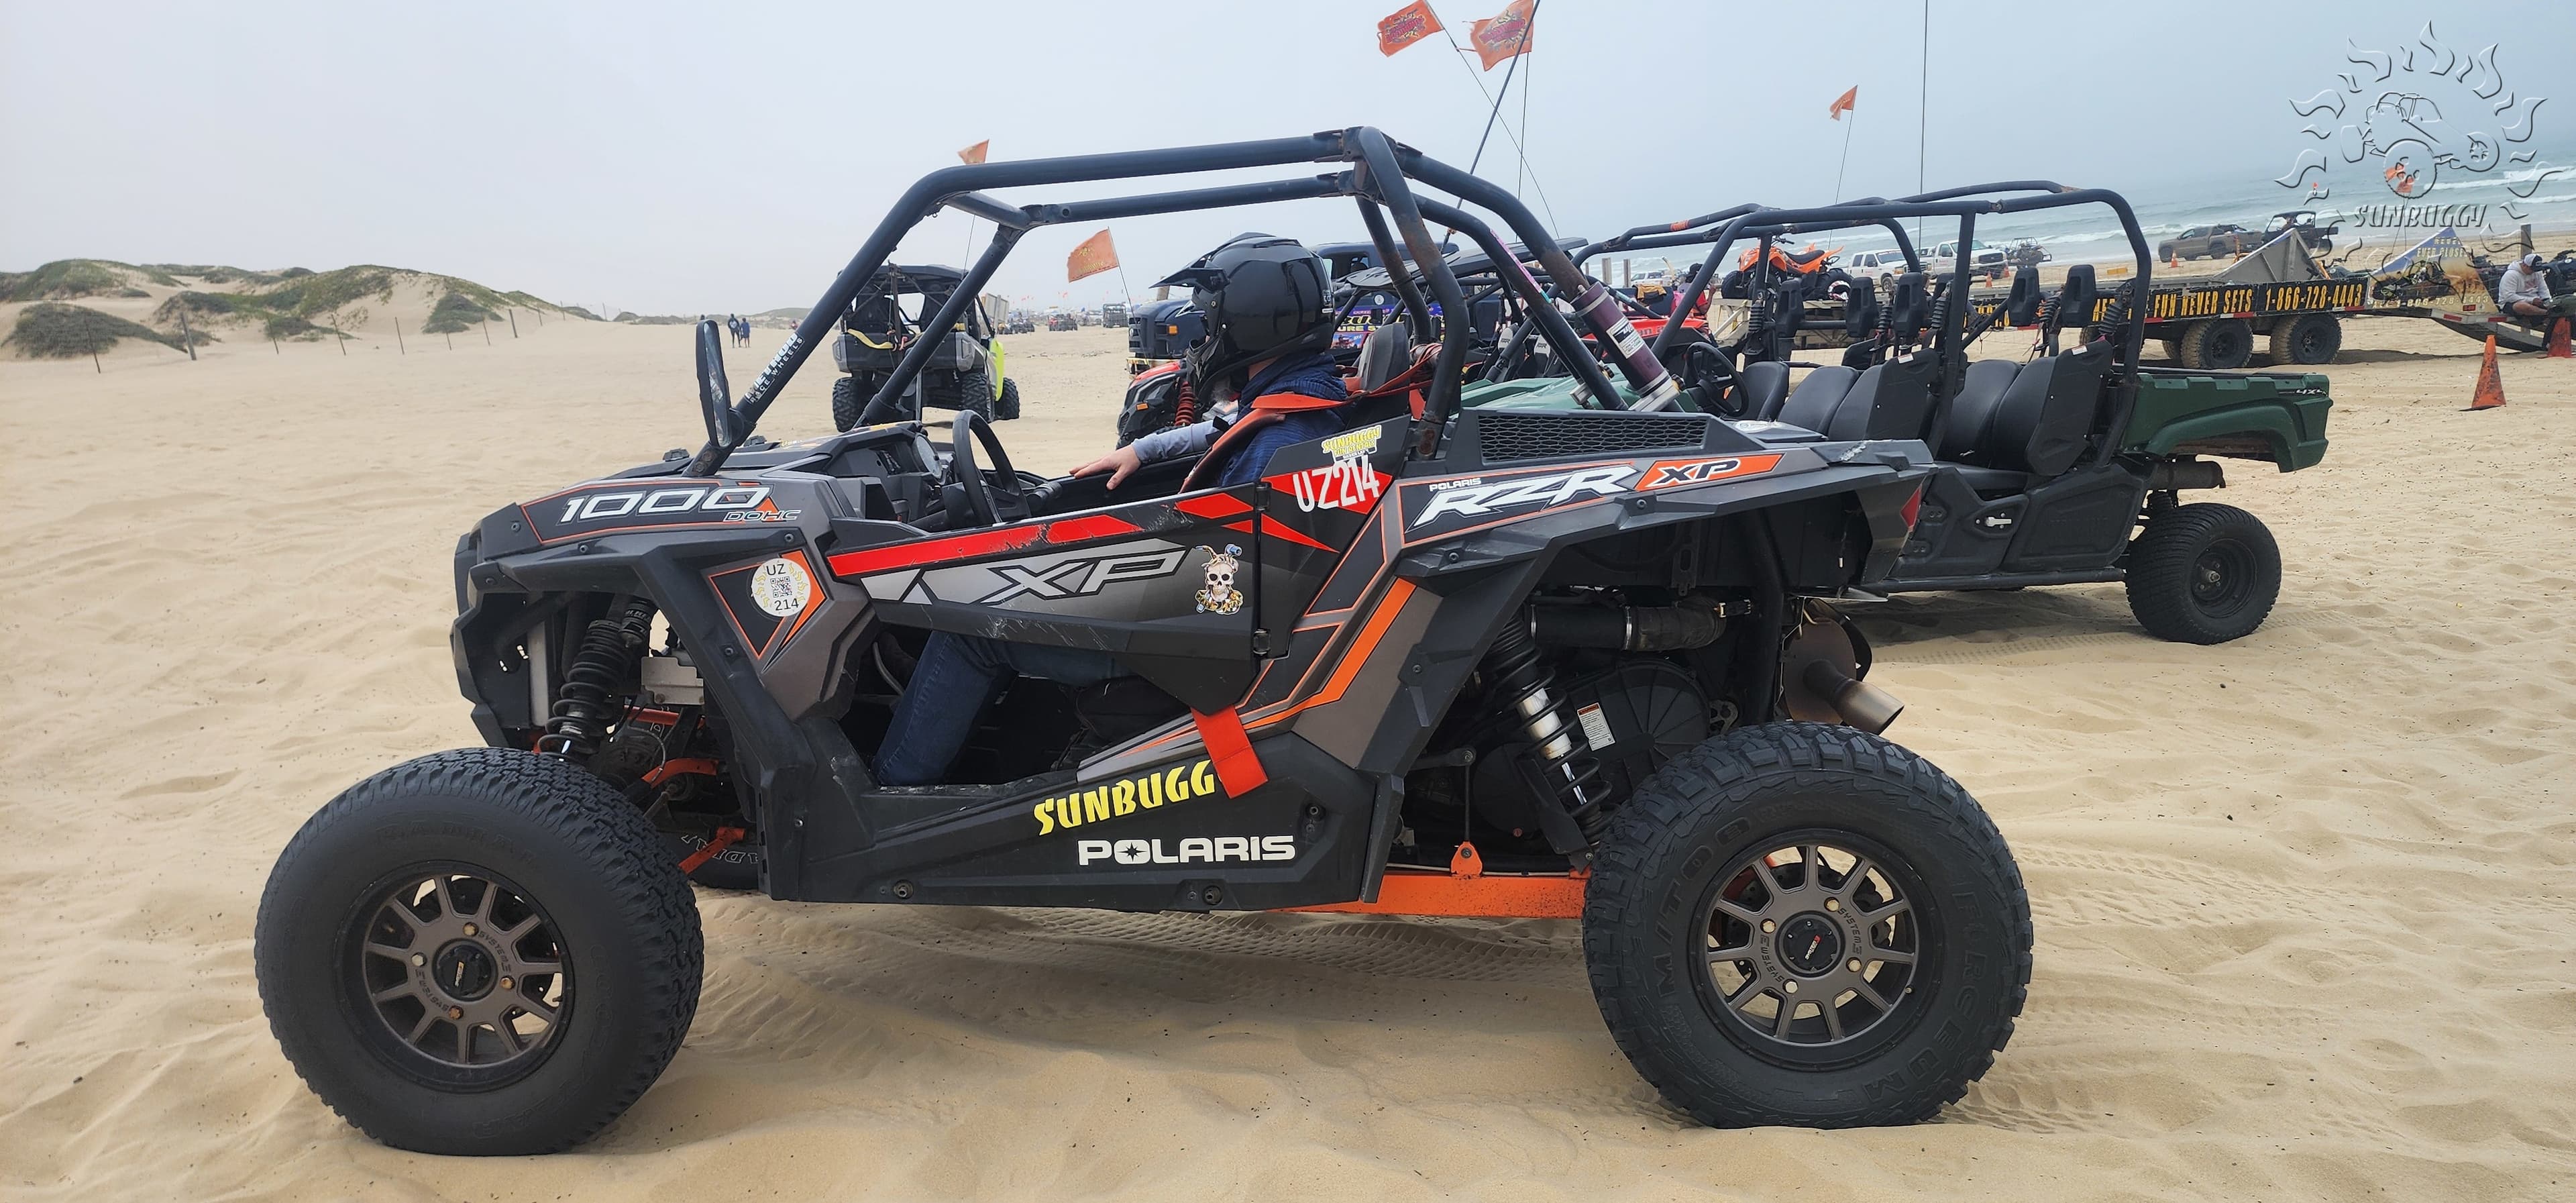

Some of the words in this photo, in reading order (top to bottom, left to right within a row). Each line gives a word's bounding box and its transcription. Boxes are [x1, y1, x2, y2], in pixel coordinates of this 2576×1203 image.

[2153, 293, 2177, 318] FUN
[2180, 291, 2219, 316] NEVER
[2222, 289, 2253, 313] SETS
[2265, 283, 2363, 311] 1-866-728-4443
[771, 337, 803, 376] WHEELS
[1323, 425, 1381, 452] SUNBUGGY
[1293, 455, 1380, 513] UZ214
[1410, 466, 1642, 529] RZR
[1655, 458, 1741, 488] XP
[1429, 478, 1482, 492] POLARIS
[559, 486, 771, 523] 1000
[723, 509, 802, 522] DOHC
[766, 563, 786, 576] UZ
[981, 547, 1185, 605] XP
[774, 598, 799, 611] 214
[1034, 760, 1216, 835] SUNBUGG
[1077, 835, 1296, 866] POLARIS
